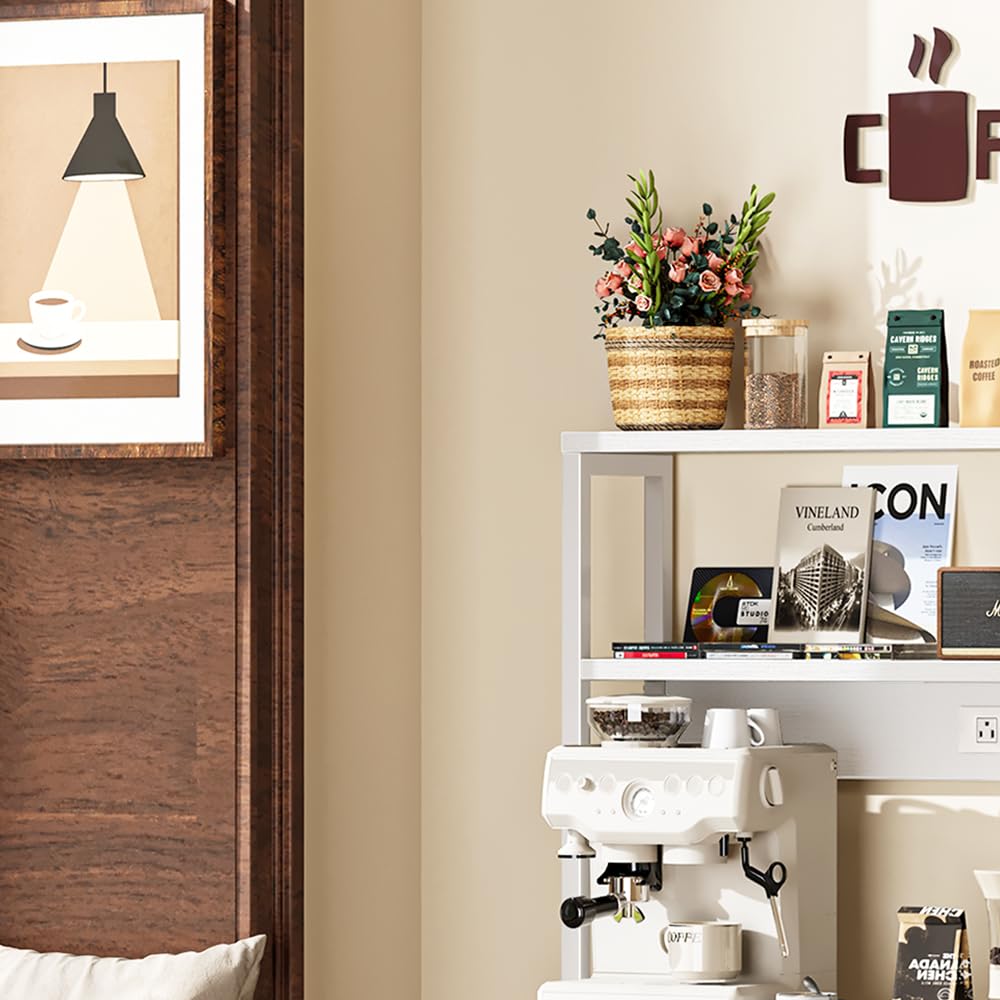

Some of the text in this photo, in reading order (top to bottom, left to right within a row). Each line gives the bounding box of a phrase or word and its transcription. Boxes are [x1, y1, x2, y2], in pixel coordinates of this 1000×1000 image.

[969, 358, 1000, 369] ROASTED
[972, 371, 996, 381] COFFEE
[851, 483, 948, 521] CON
[796, 506, 860, 519] VINELAND
[807, 523, 845, 531] Cumberland
